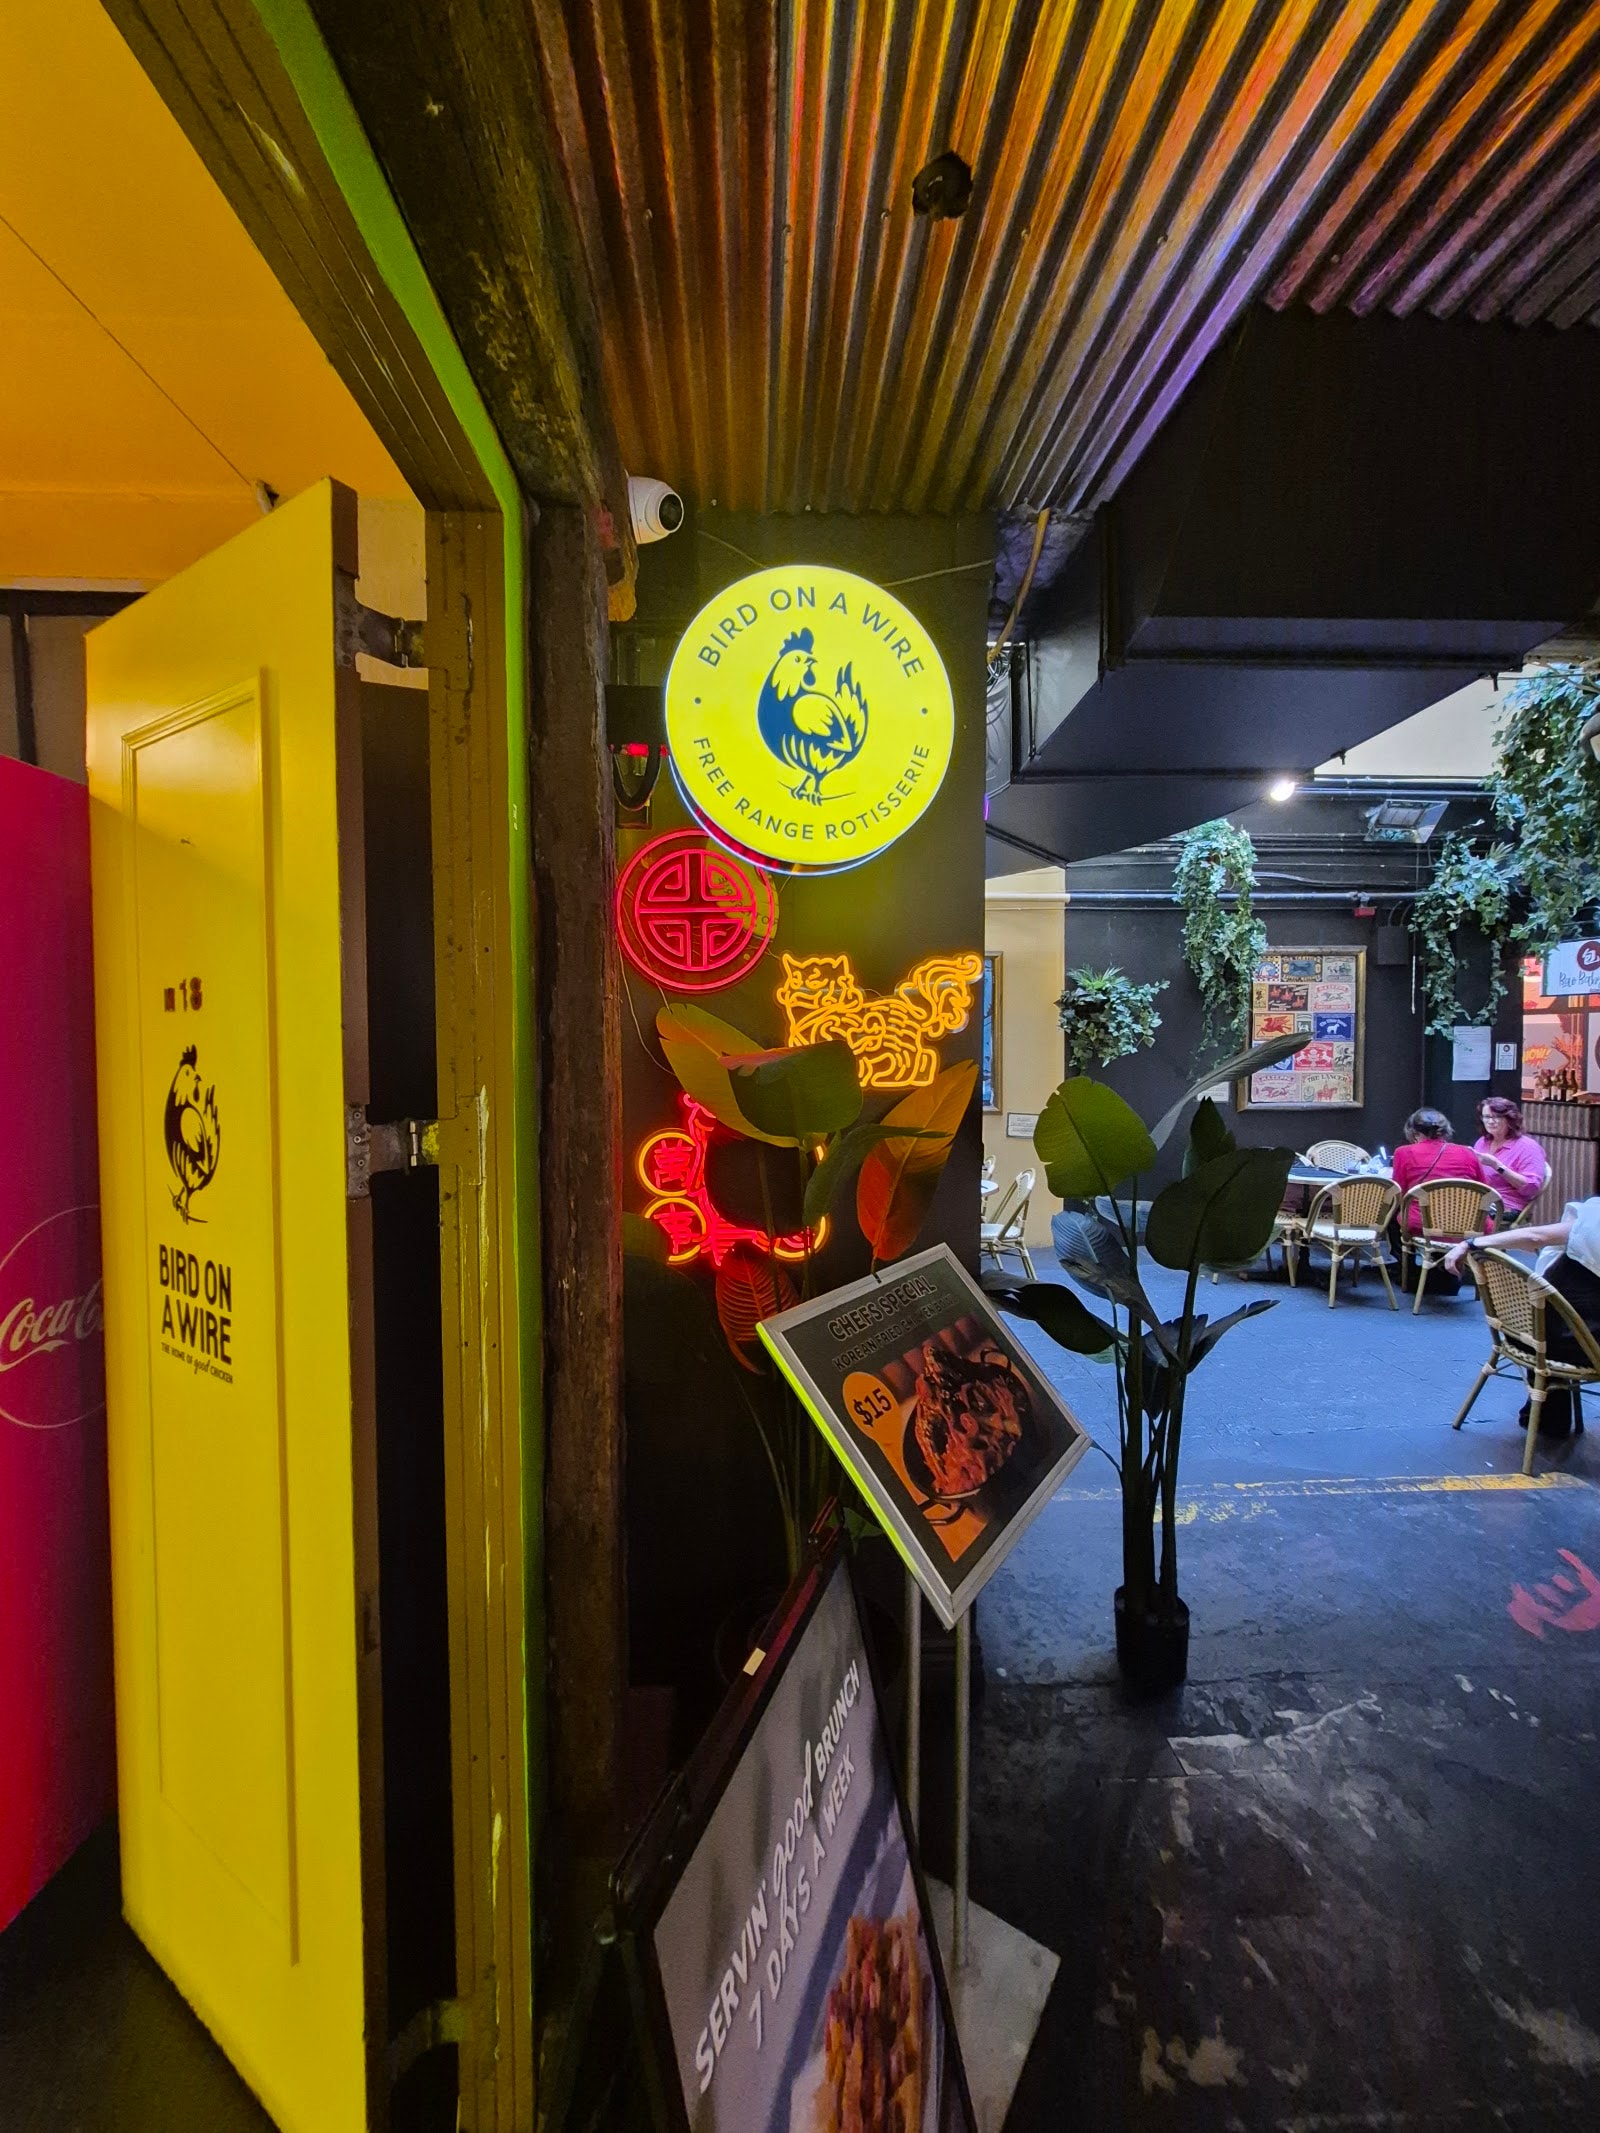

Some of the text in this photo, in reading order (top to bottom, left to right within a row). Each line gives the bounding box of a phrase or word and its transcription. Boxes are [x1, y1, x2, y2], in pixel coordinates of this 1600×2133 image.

[698, 586, 924, 678] BIRD ON A WIRE
[693, 737, 930, 840] FREE RANGE ROTISSERIE
[159, 1244, 232, 1313] BIRD ON
[828, 1275, 937, 1341] CHEFS SPECIAL
[161, 1294, 232, 1366] A WIRE
[832, 1338, 878, 1372] KOREAN
[874, 1325, 904, 1348] FRIED
[853, 1388, 892, 1427] $15
[696, 1659, 860, 2094] SERVIN' good BRUNCH
[750, 1744, 855, 2049] 7 DAYS A WEEK
